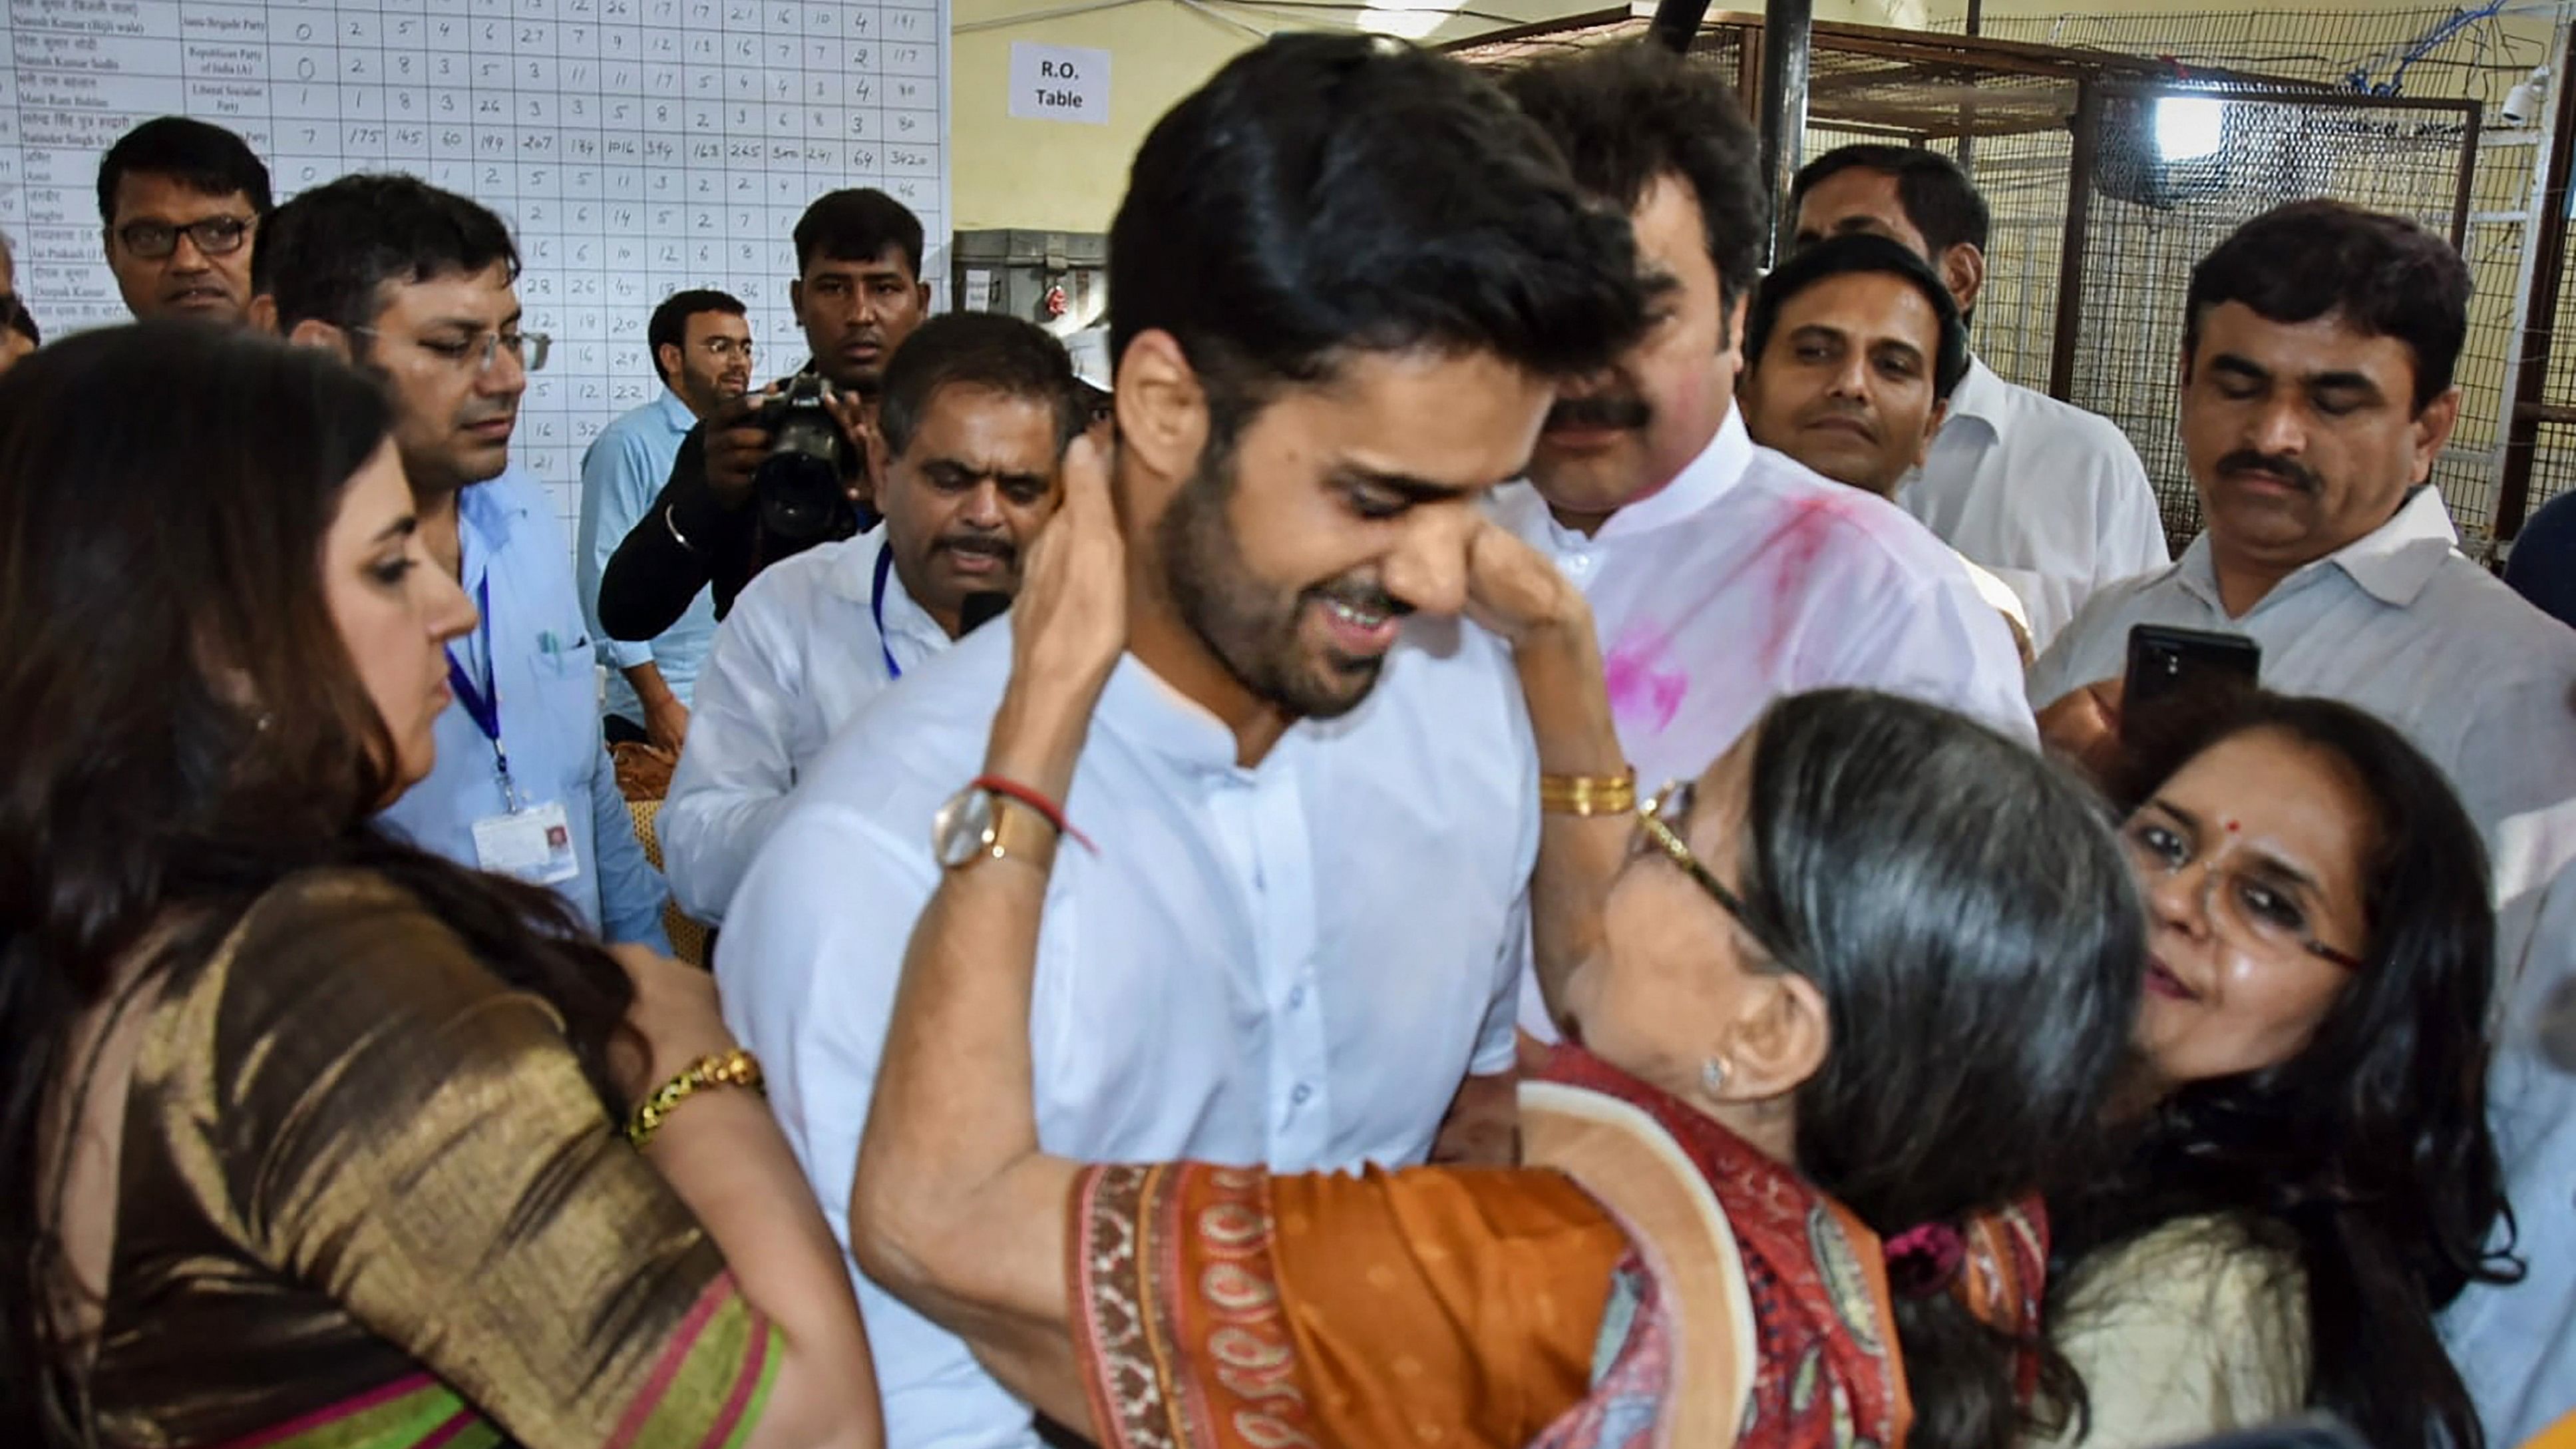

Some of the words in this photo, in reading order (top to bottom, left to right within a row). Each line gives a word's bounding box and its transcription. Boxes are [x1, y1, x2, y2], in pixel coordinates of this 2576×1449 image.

[296, 23, 311, 41] 0
[349, 21, 362, 36] 2
[399, 21, 417, 34] 5
[854, 13, 868, 33] 4
[297, 57, 316, 81] 0
[351, 59, 365, 74] 2
[399, 56, 411, 75] 8
[439, 58, 451, 75] 3
[482, 63, 500, 77] 5
[572, 66, 586, 84] 11
[615, 71, 628, 87] 11
[699, 75, 713, 89] 5
[855, 77, 869, 101] 4
[1041, 61, 1079, 79] R.O.
[1035, 89, 1083, 108] Table
[301, 87, 308, 106] 1
[356, 89, 361, 108] 1
[399, 92, 411, 110] 8
[440, 93, 454, 111] 3
[612, 104, 630, 120] 5
[696, 113, 710, 128] 2
[852, 116, 863, 134] 3
[301, 128, 316, 144] 7
[301, 166, 316, 181] 0
[484, 167, 502, 184] 2
[530, 170, 547, 186] 5
[530, 206, 542, 221] 2
[576, 206, 588, 222] 6
[697, 213, 713, 228] 2
[536, 383, 552, 397] 5
